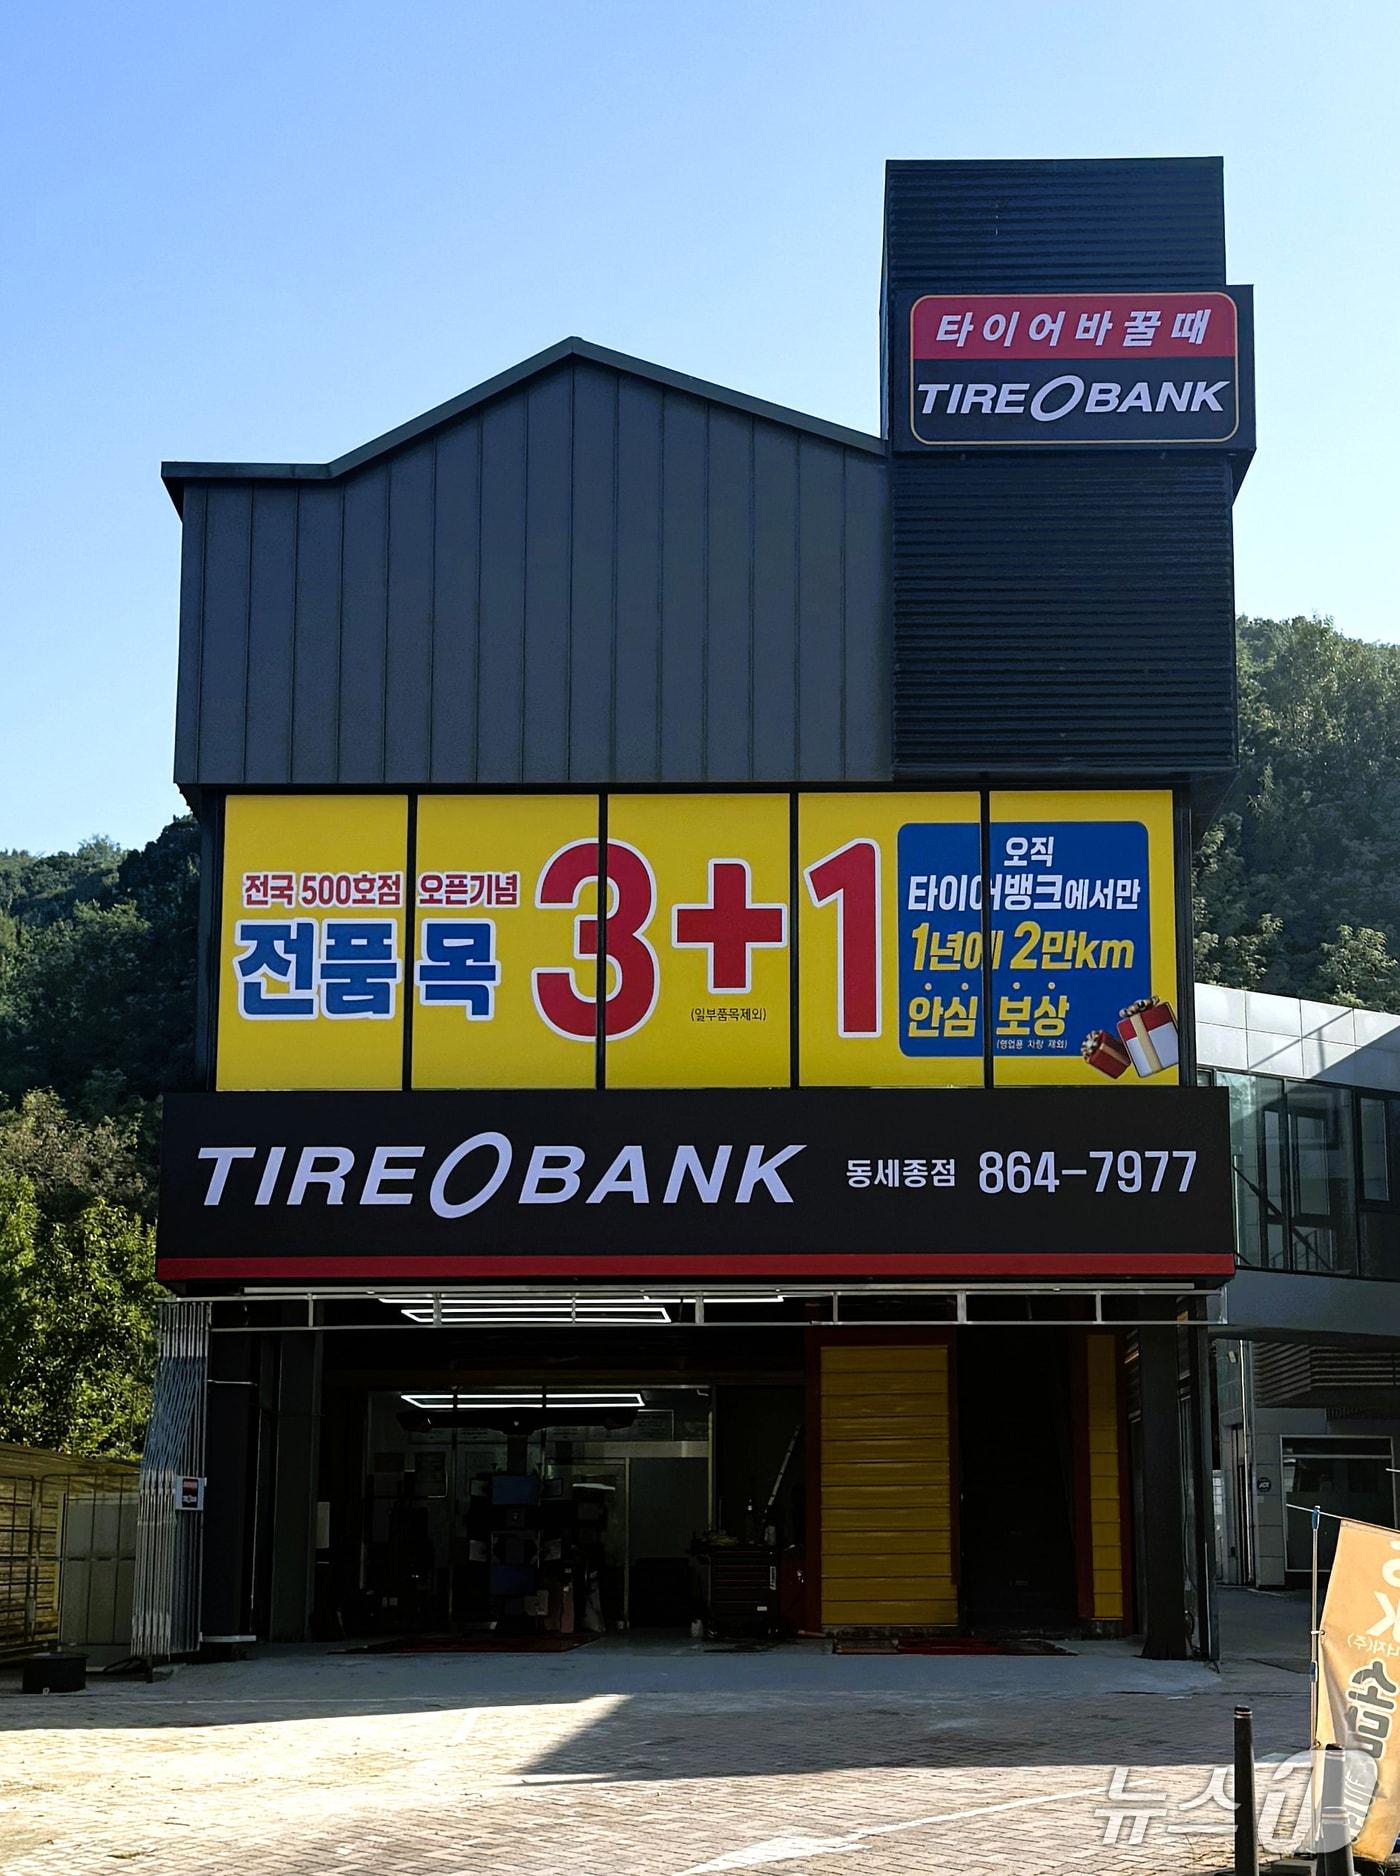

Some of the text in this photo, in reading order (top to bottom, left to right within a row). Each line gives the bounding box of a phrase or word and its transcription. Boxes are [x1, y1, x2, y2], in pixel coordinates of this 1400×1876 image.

[917, 375, 1230, 422] TIREOBANK
[1003, 836, 1055, 867] 오직
[244, 873, 519, 906] 전국 500호점 오픈기념
[907, 873, 1141, 911] 타이어뱅크에서만
[1010, 921, 1135, 970] 2만km
[235, 920, 499, 1018] 전품목
[690, 1008, 767, 1022] (일부품목제외)
[908, 995, 1070, 1037] 안심 보상
[198, 1131, 807, 1219] TIREOBANK
[845, 1150, 1198, 1194] 동세종점 864-7977
